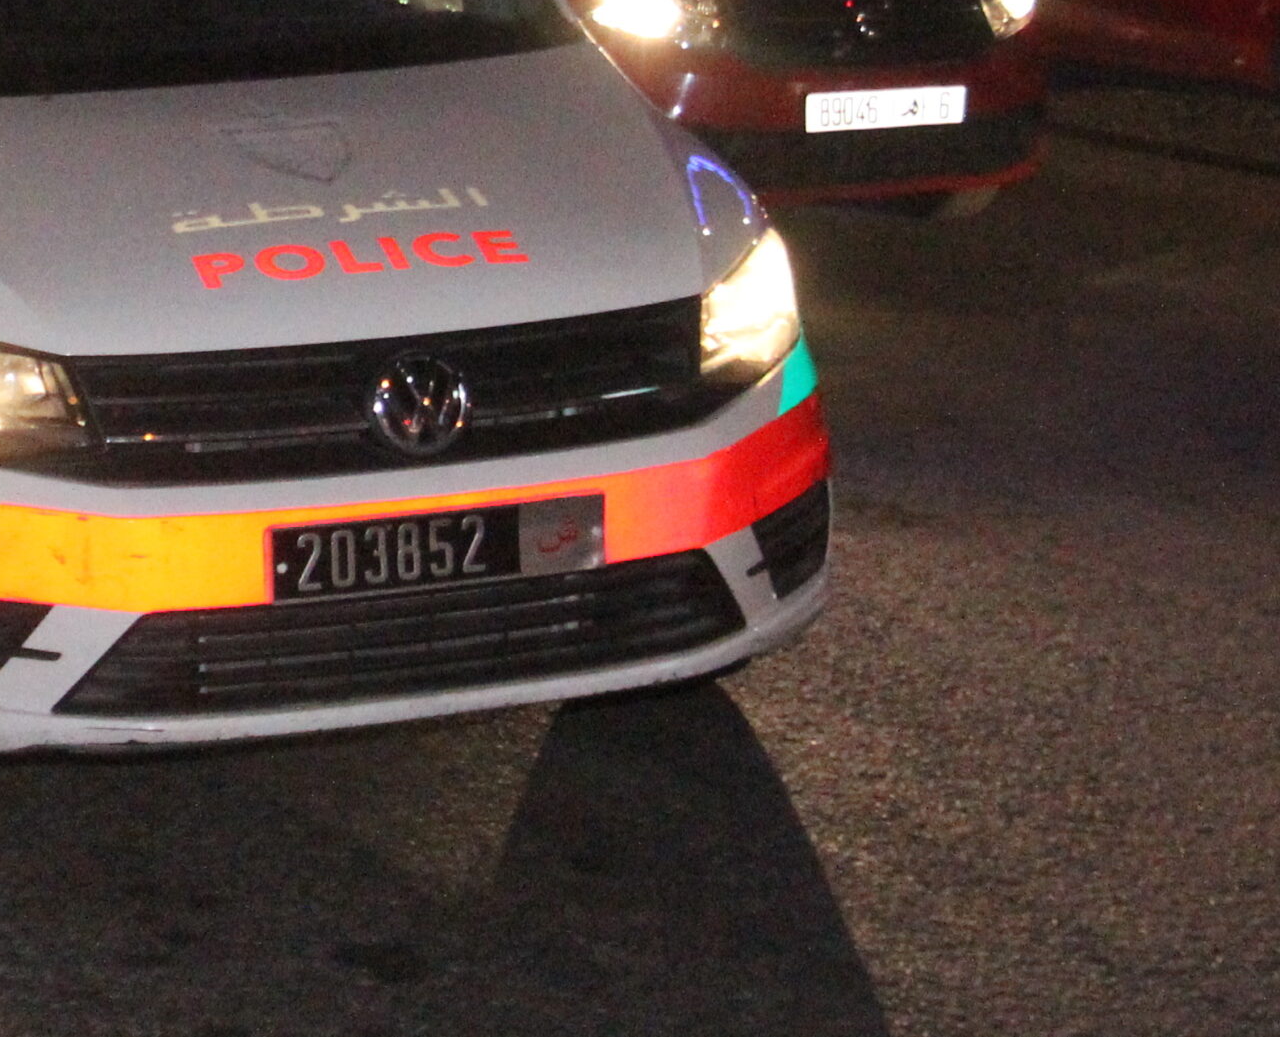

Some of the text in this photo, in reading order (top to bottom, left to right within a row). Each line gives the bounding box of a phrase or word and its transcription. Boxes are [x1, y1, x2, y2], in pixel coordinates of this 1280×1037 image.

[171, 186, 489, 234] الشرطة
[190, 229, 531, 290] POLICE
[297, 514, 487, 591] 203852
